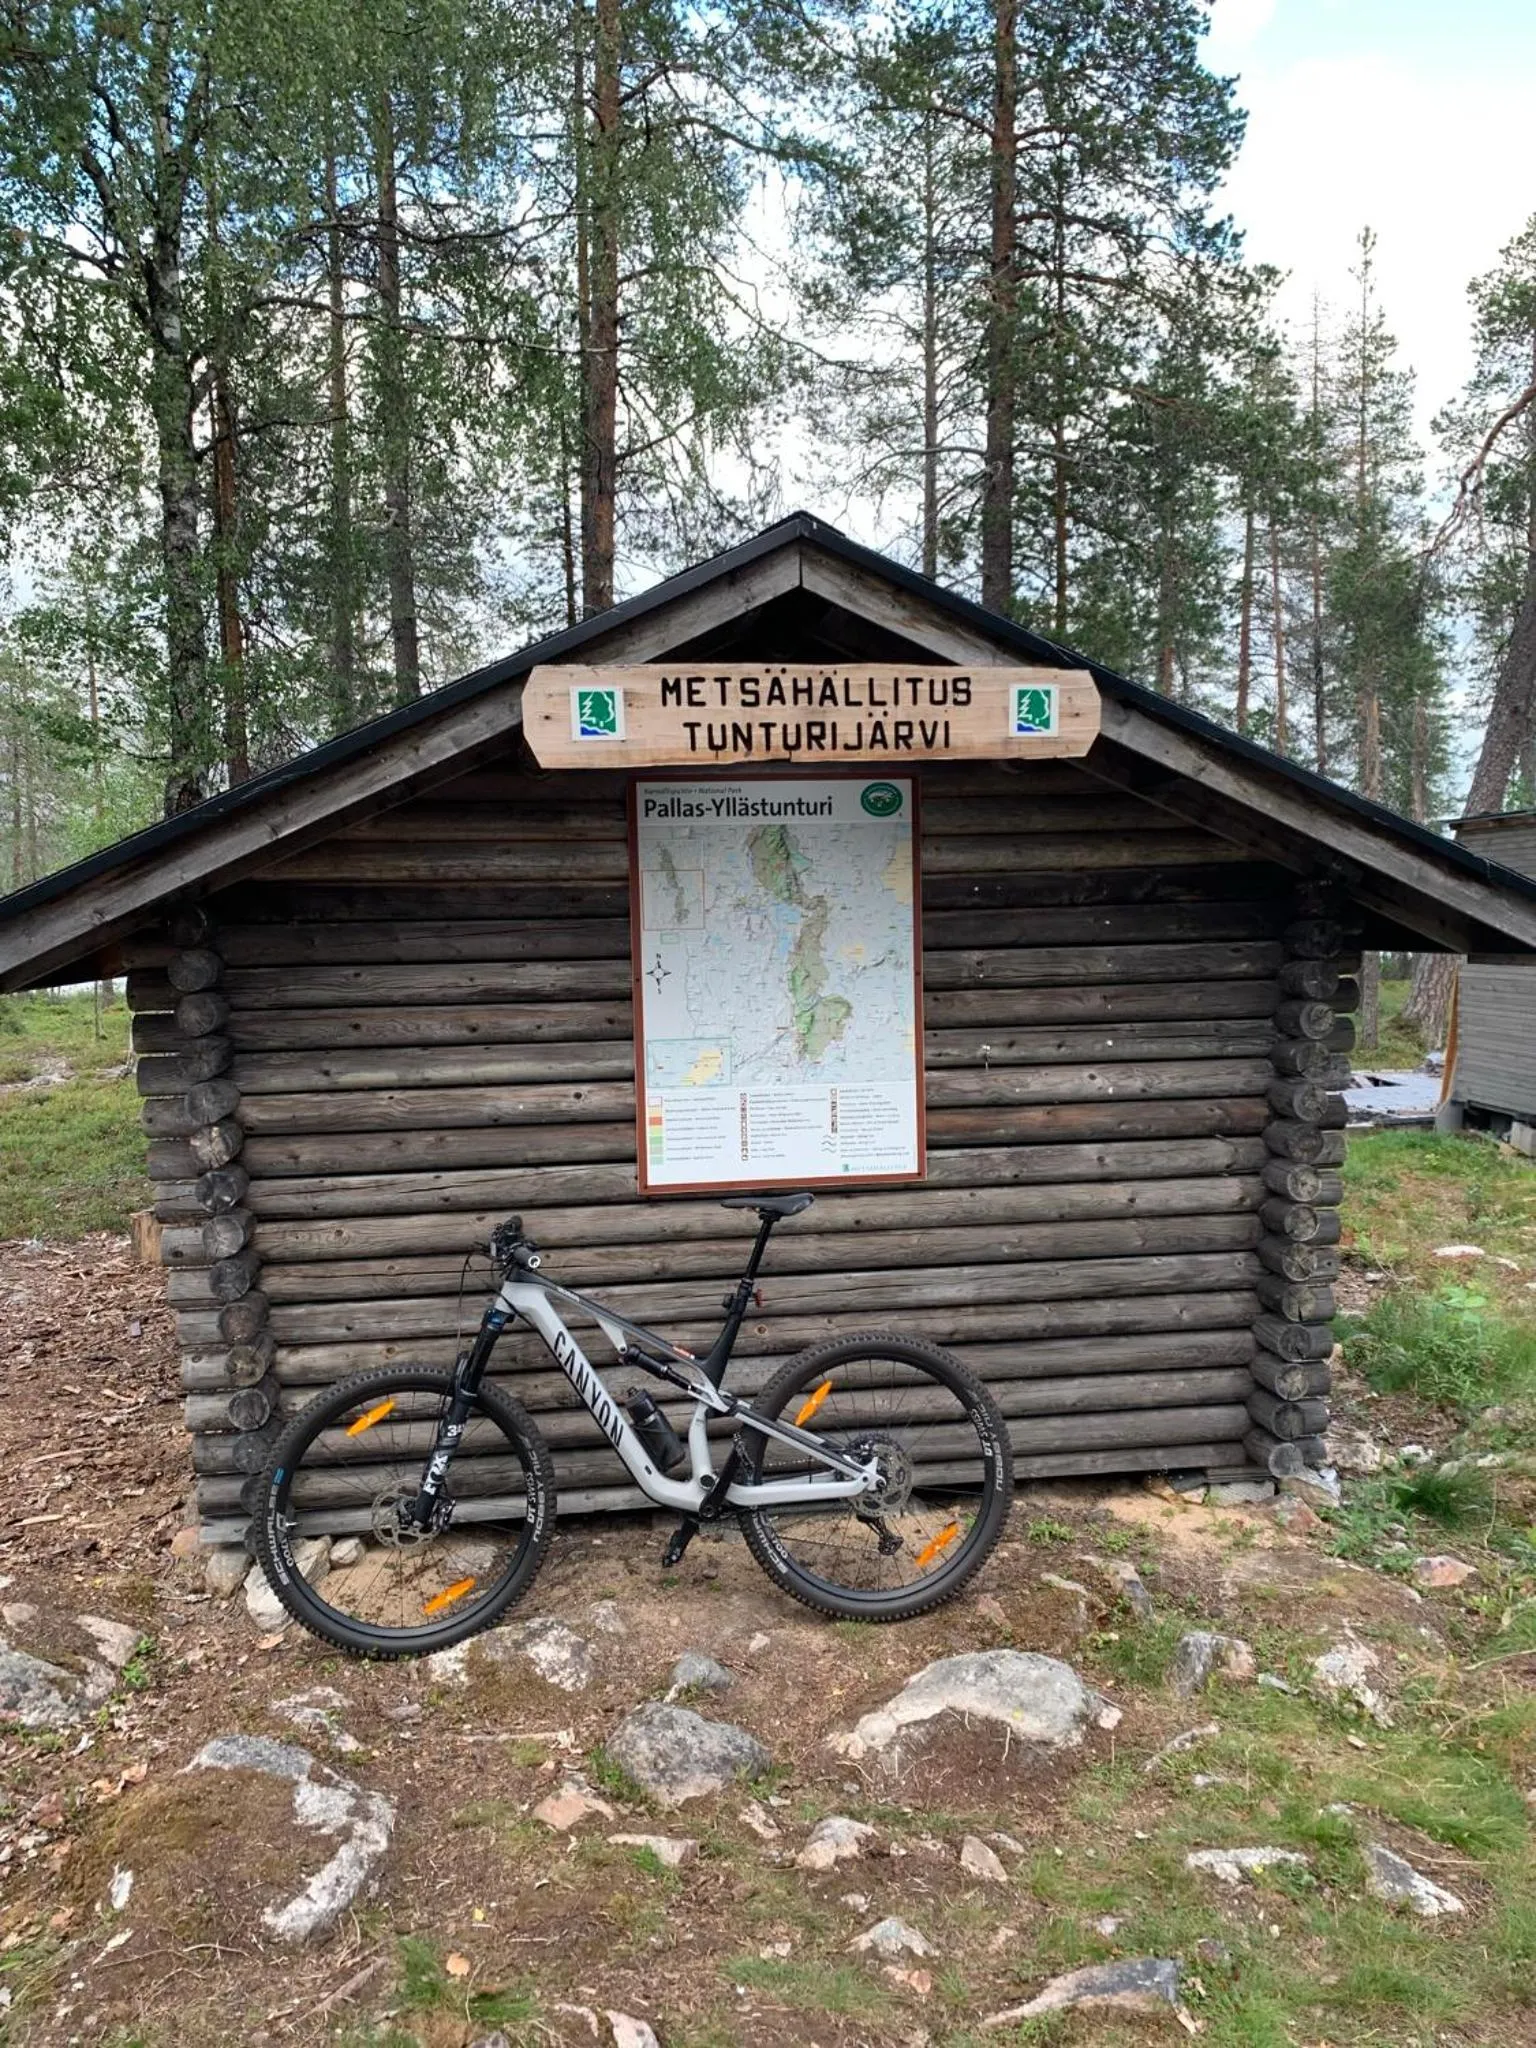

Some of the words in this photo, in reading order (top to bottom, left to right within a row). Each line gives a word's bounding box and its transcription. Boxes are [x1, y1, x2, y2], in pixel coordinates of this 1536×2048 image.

[660, 667, 972, 707] METSÄHÄLLITUS
[682, 710, 951, 753] TUNTURIJÄRVI
[643, 796, 833, 818] Pallas-Yllästunturi
[553, 1330, 624, 1447] CANYON
[422, 1453, 450, 1495] FOX
